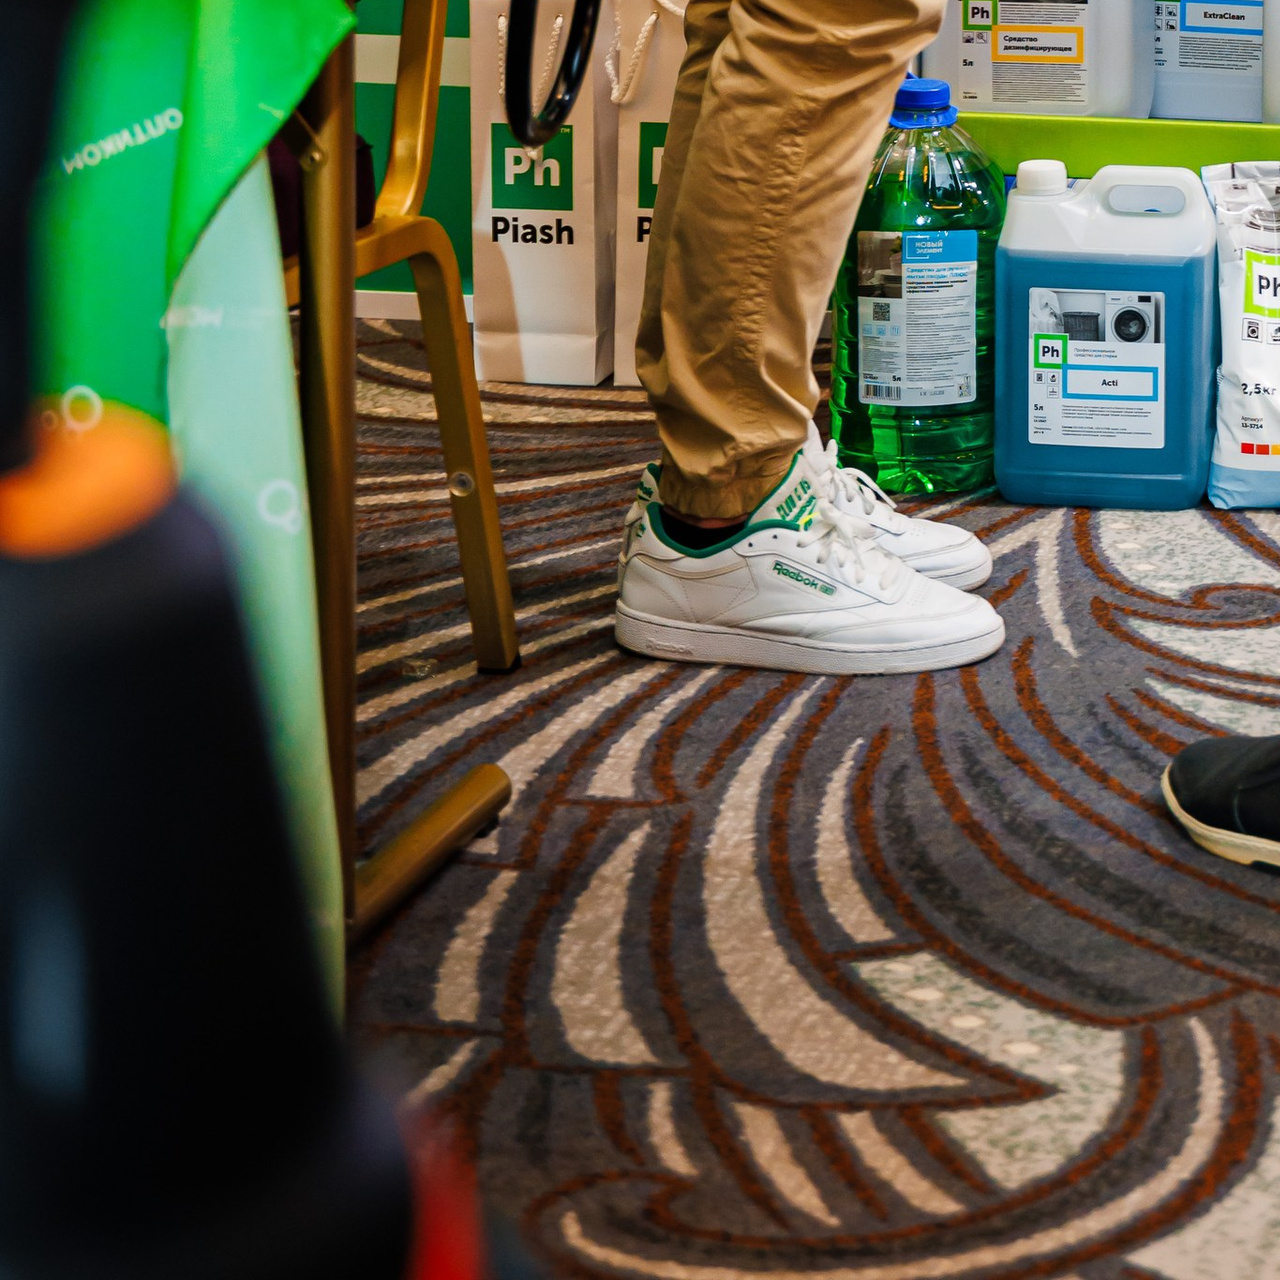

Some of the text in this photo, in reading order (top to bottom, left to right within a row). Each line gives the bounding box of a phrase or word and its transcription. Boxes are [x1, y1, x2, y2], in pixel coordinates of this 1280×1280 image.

[971, 6, 990, 19] Ph
[1203, 11, 1246, 21] ExtraClean
[1003, 35, 1038, 43] Средство
[1003, 45, 1073, 53] дезинфицирующее
[962, 59, 974, 67] 5л
[504, 146, 561, 187] Ph
[491, 216, 575, 245] Piash
[1042, 345, 1060, 358] Ph
[1101, 379, 1118, 387] Acti
[1241, 383, 1277, 397] 2,5кг
[1033, 403, 1044, 411] 5л
[773, 561, 819, 590] Reebok
